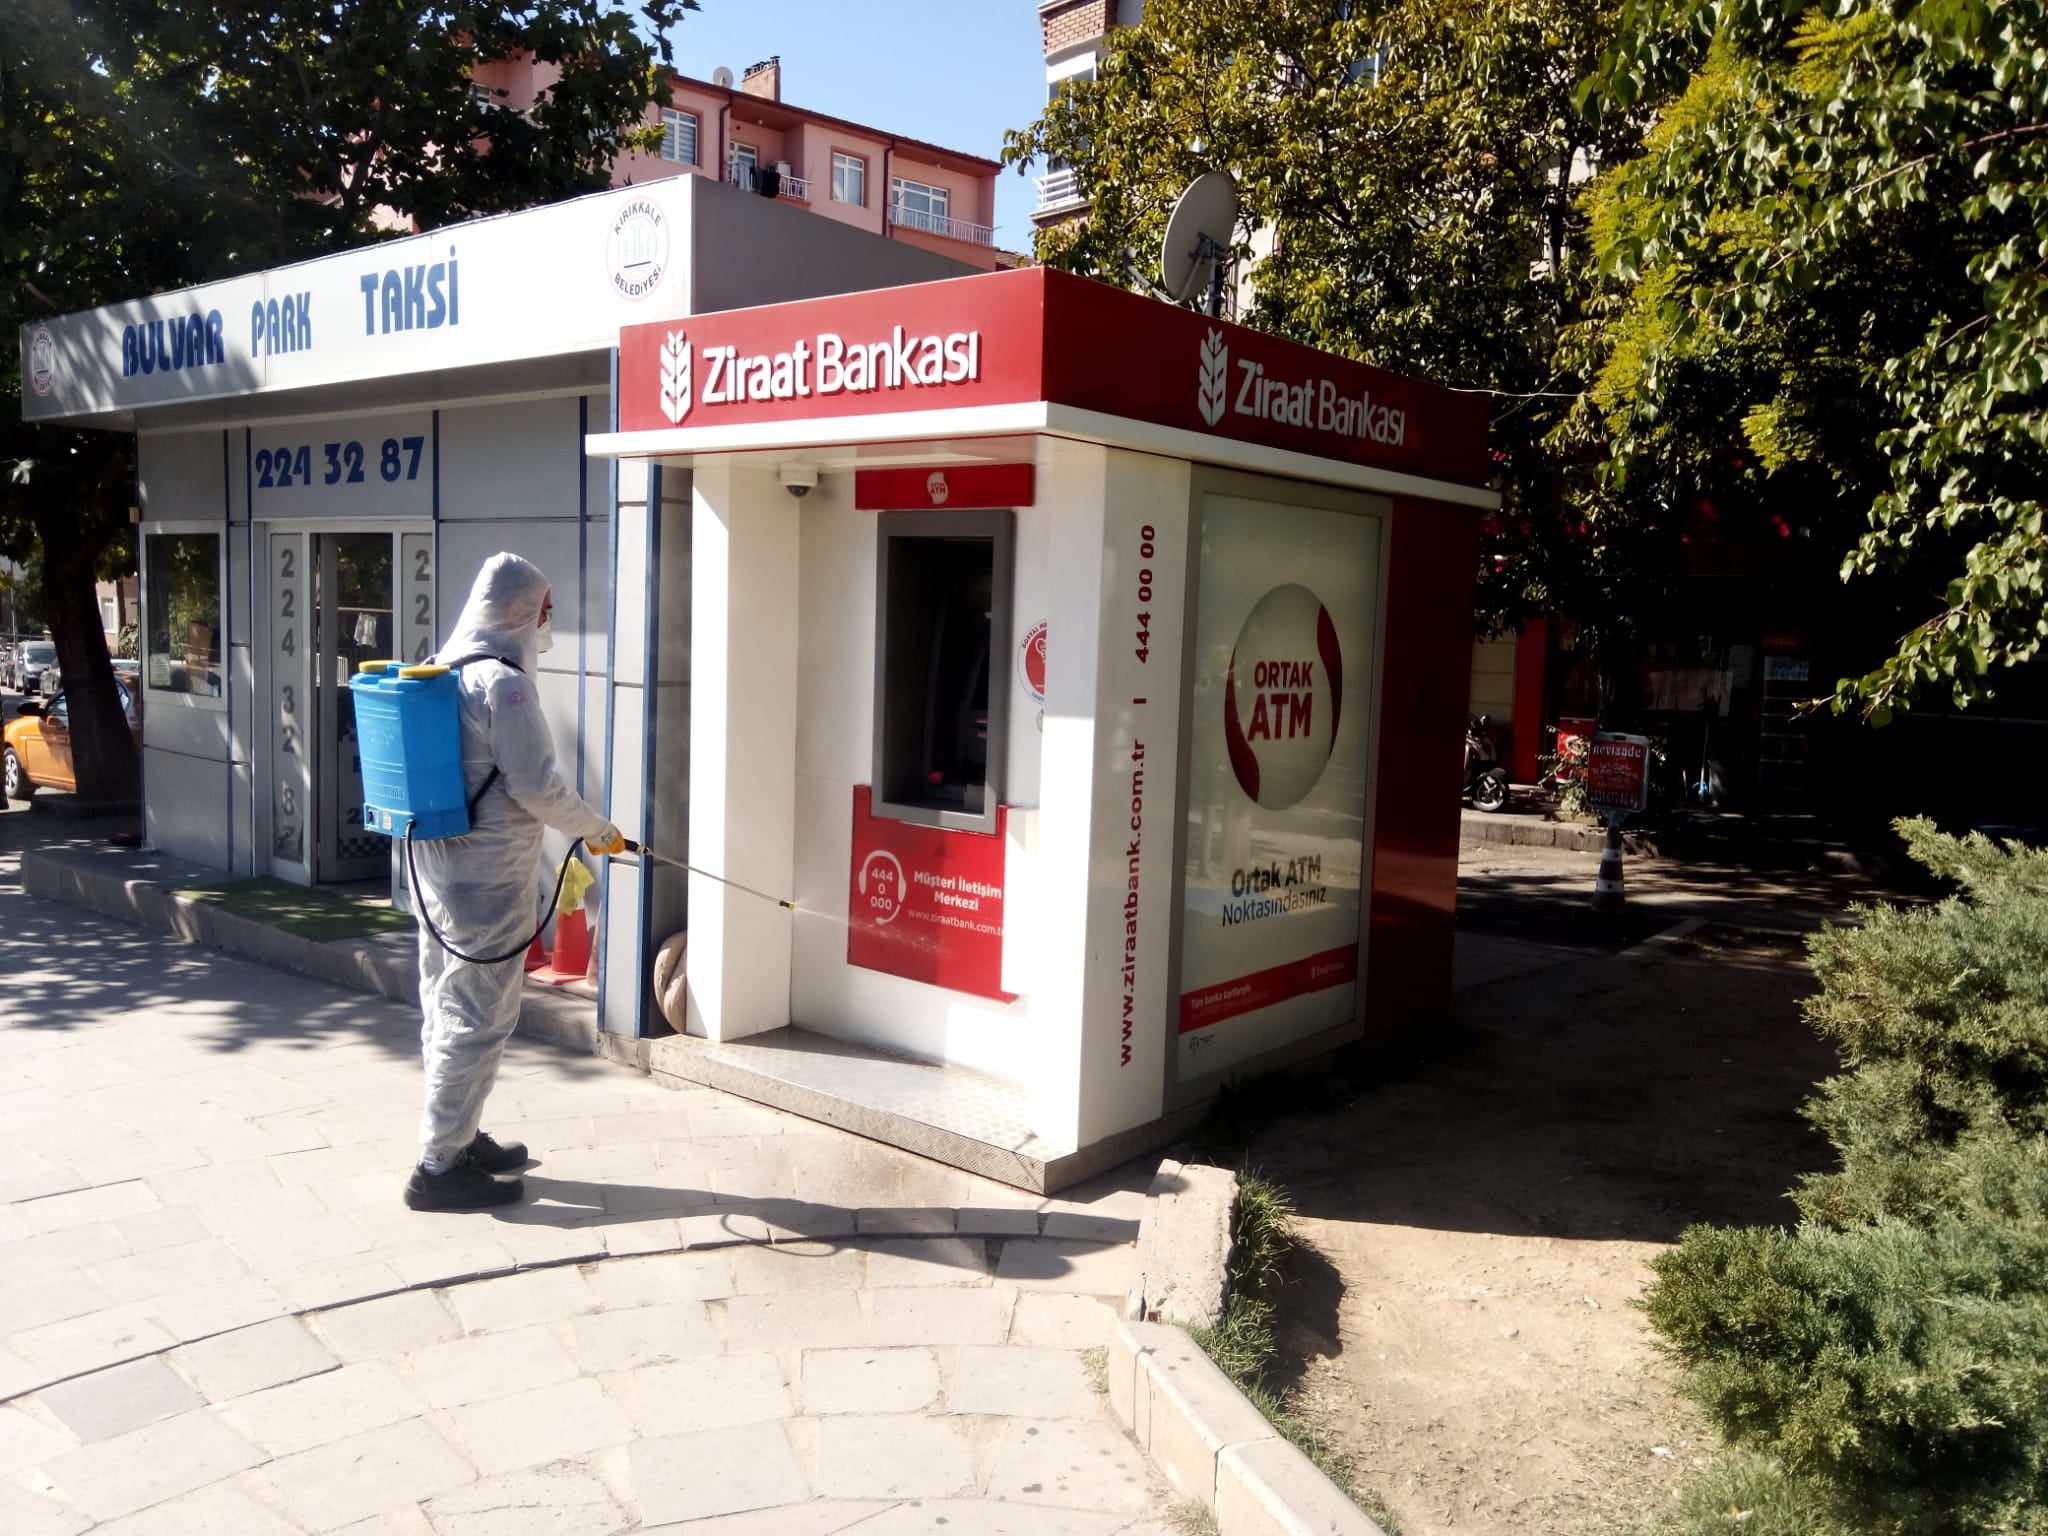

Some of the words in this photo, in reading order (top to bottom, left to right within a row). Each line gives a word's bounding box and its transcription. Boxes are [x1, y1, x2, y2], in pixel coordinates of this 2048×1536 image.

[614, 201, 662, 235] KIRIKKALE
[122, 309, 225, 377] BULVAR
[251, 291, 312, 358] PARK
[360, 244, 459, 336] TAKSİ
[702, 340, 811, 403] Ziraat
[816, 325, 980, 393] Bankası
[1234, 358, 1315, 429] Ziraat
[1318, 379, 1406, 446] Bankası
[255, 445, 312, 488] 224
[325, 441, 365, 485] 32
[380, 436, 425, 482] 87
[1140, 525, 1155, 559] 00
[1138, 568, 1153, 602] 00
[1135, 611, 1151, 664] 444
[1254, 660, 1314, 690] ORTAK
[1246, 692, 1313, 742] ATM
[871, 868, 893, 882] 444
[878, 883, 886, 895] 0
[914, 870, 956, 890] Müşteri
[958, 876, 1002, 899] İletişim
[1231, 861, 1282, 898] Ortak
[1284, 853, 1321, 887] ATM
[870, 896, 892, 910] 000
[934, 891, 979, 911] Merkezi
[1120, 738, 1145, 1068] www.ziraatbank.com.tr
[1222, 886, 1327, 927] Noktasındasınız
[908, 908, 1003, 936] www.ziraatbank.com.t
